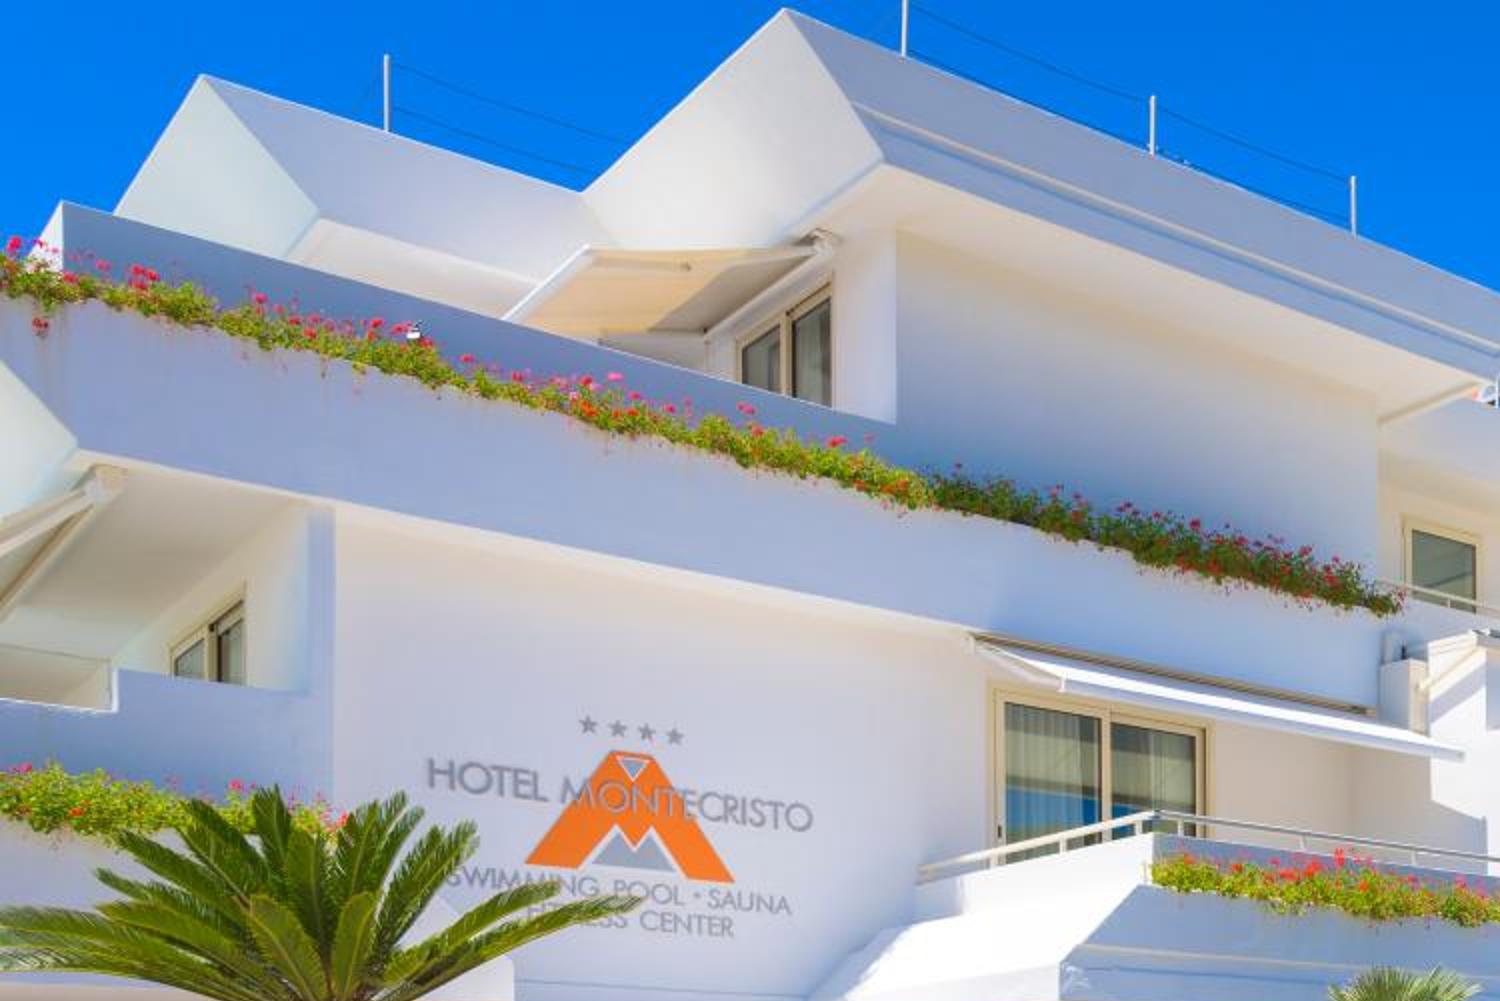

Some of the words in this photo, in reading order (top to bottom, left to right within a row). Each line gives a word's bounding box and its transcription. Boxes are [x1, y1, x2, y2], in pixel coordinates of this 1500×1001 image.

[427, 757, 549, 803] HOTEL
[560, 776, 813, 832] MONTECRISTO
[613, 879, 686, 906] POOL
[707, 888, 791, 915] SAUNA
[639, 910, 734, 937] CENTER
